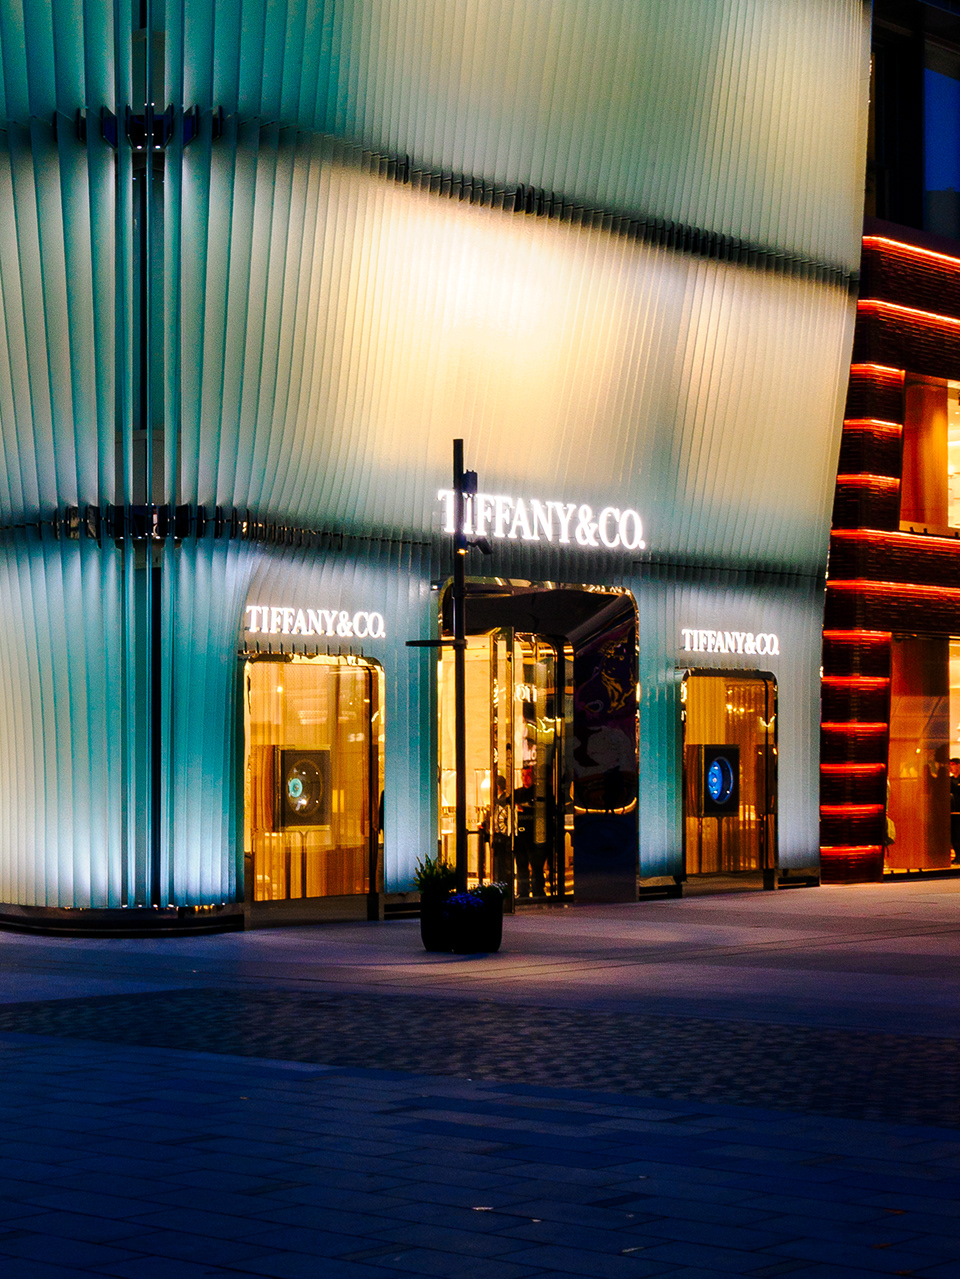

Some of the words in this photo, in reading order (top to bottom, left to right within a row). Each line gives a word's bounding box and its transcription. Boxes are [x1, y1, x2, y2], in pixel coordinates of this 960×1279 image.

[438, 489, 646, 549] TIFFANY&CO.
[246, 605, 386, 638] TIFFANY&CO.
[681, 628, 780, 656] TIFFANY&CO.
